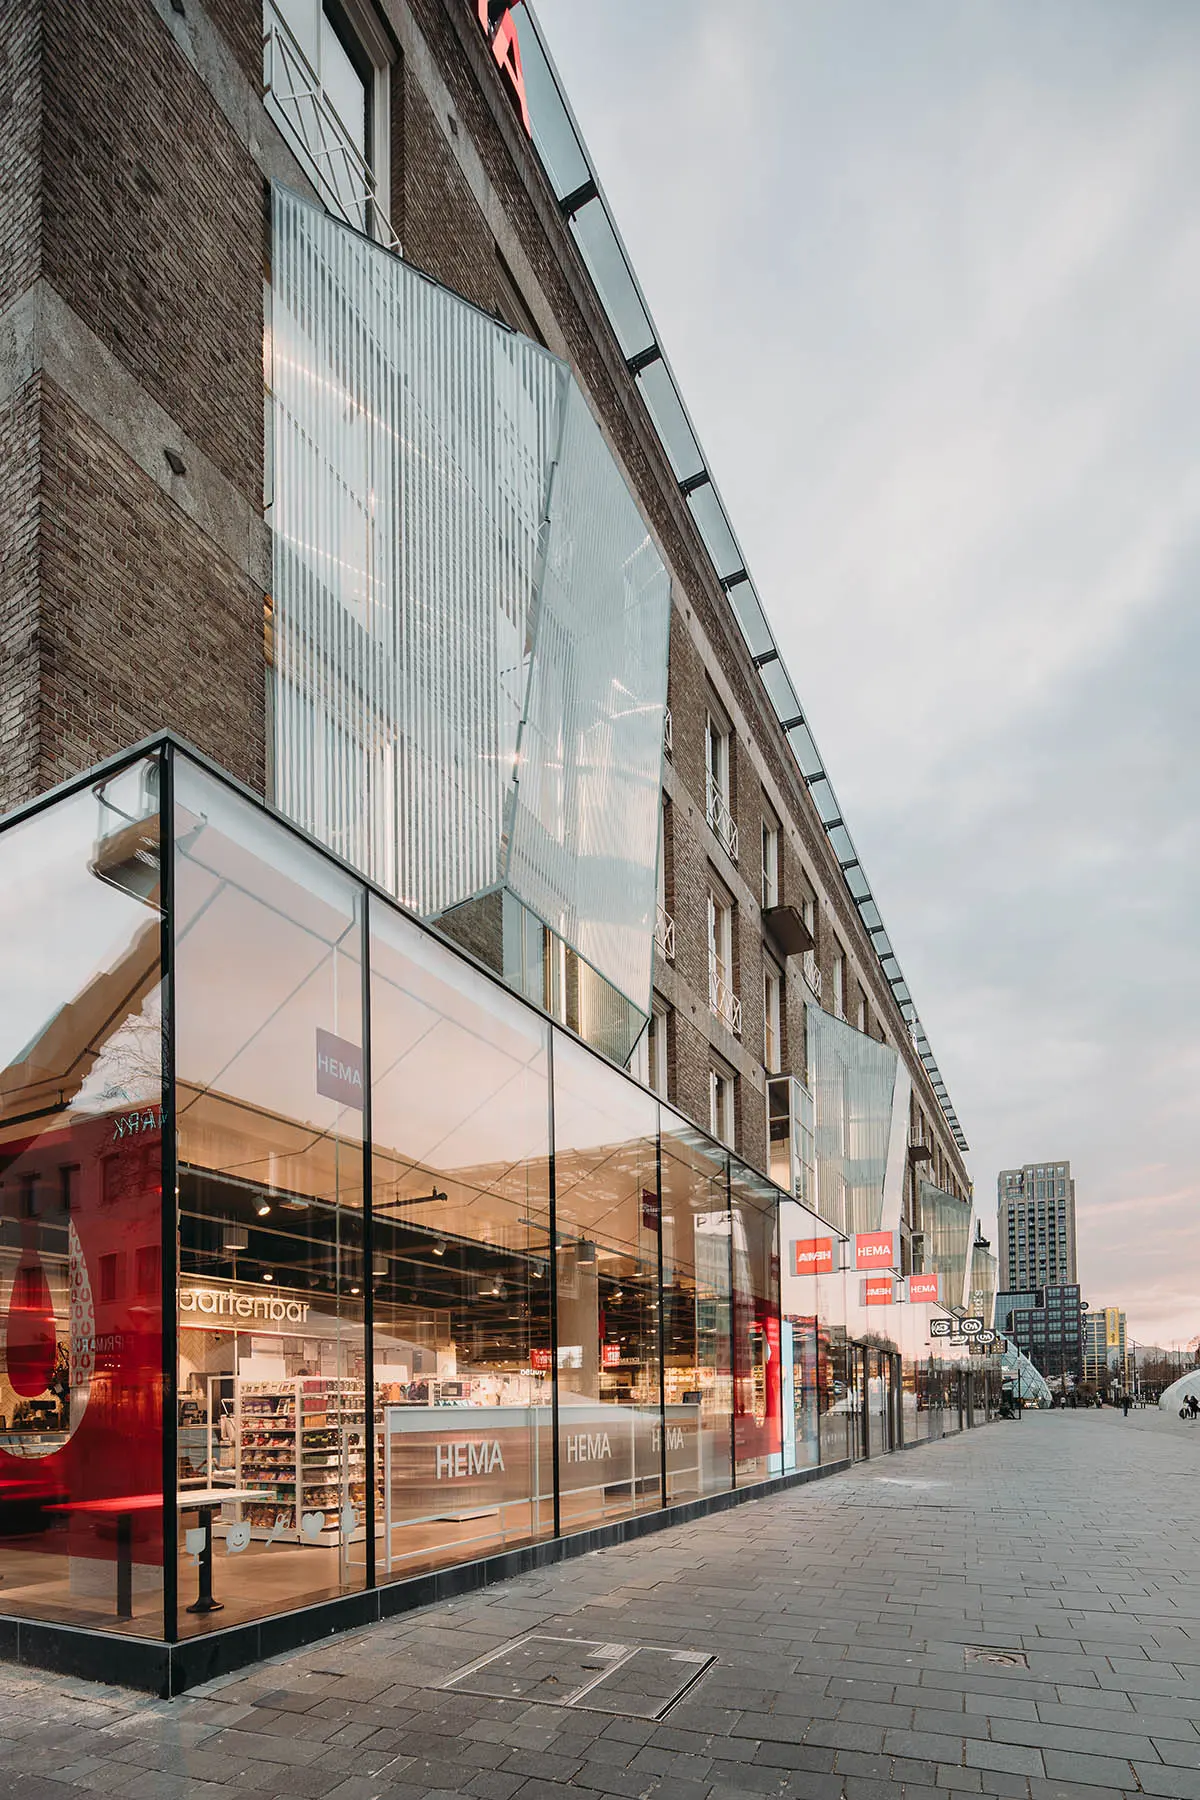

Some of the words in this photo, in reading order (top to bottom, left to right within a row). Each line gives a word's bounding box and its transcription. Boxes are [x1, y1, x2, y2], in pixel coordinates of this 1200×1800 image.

[478, 0, 533, 140] A
[317, 1051, 362, 1089] HEMA
[857, 1245, 891, 1257] HEMA
[178, 1288, 310, 1323] aartenbar
[910, 1285, 937, 1293] HEMA
[567, 1432, 612, 1463] HEMA
[652, 1427, 685, 1452] HMA
[436, 1439, 505, 1480] HEMA
